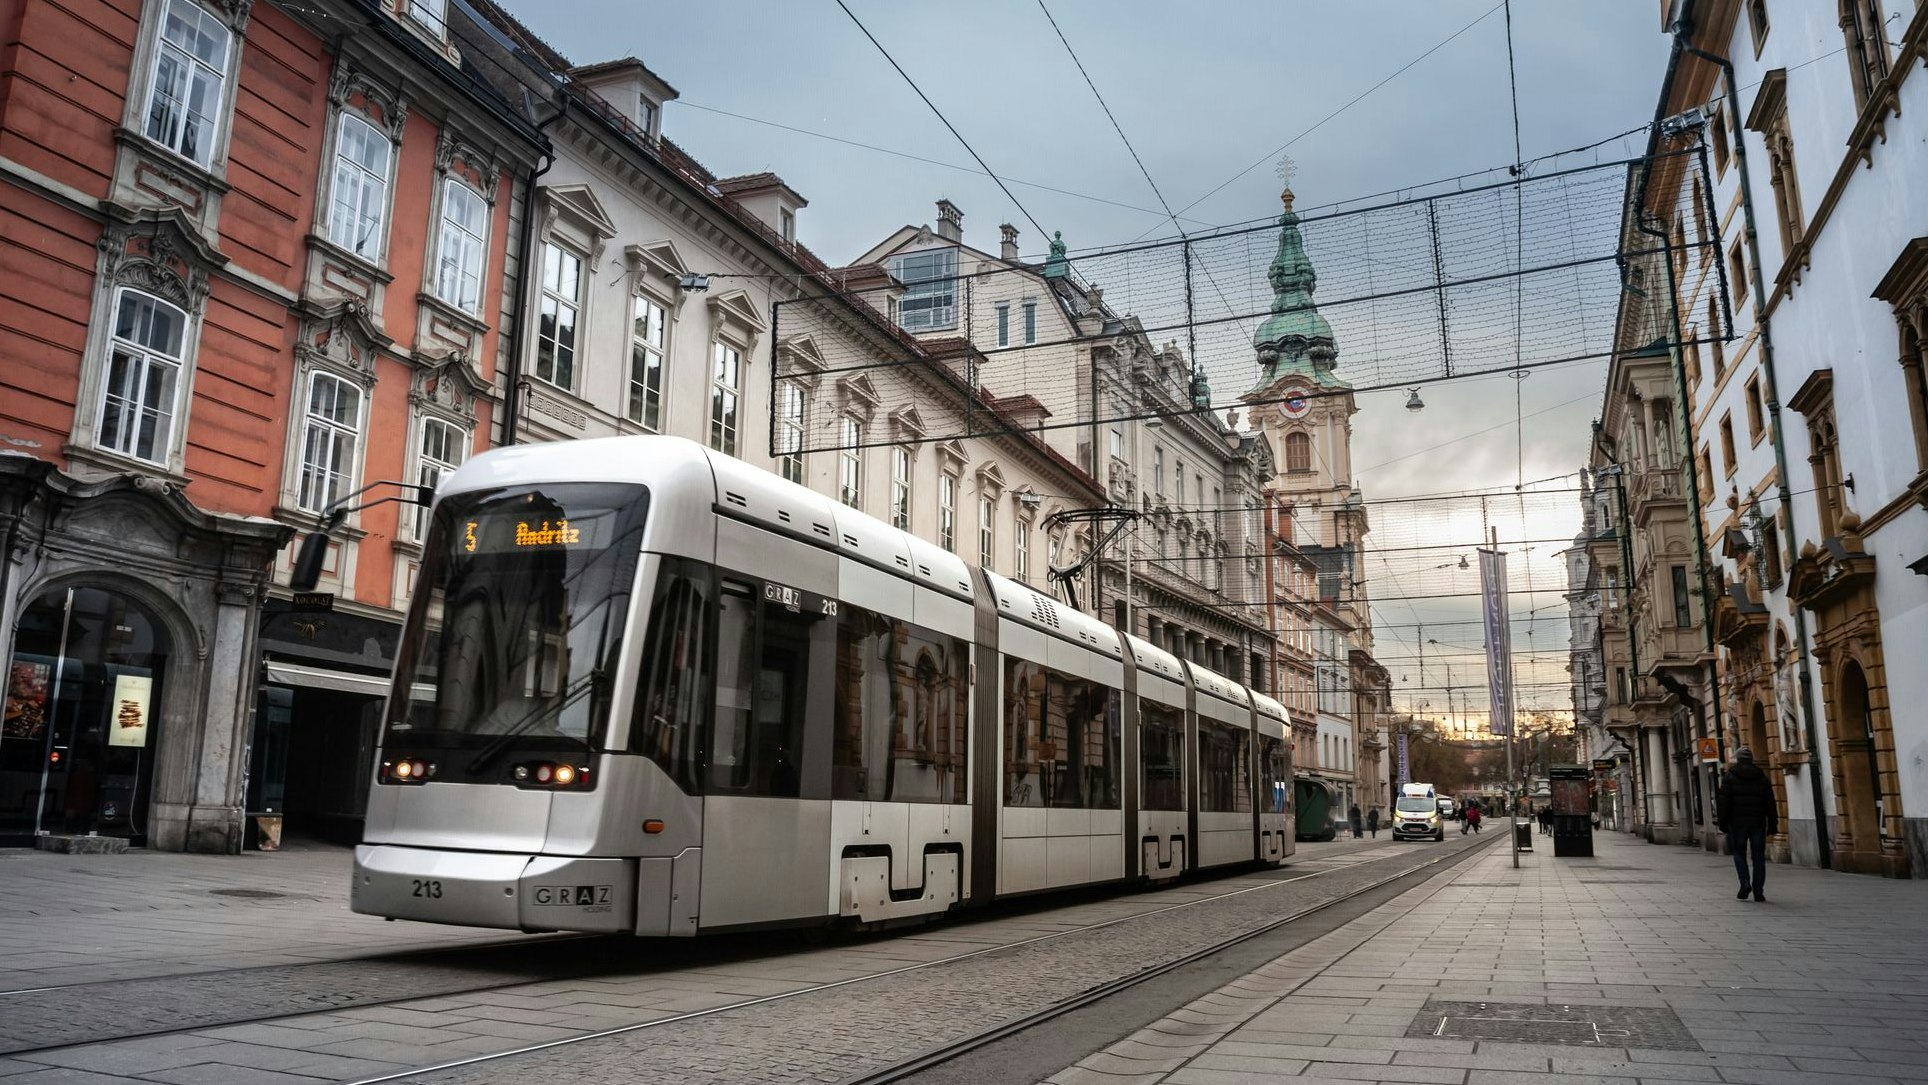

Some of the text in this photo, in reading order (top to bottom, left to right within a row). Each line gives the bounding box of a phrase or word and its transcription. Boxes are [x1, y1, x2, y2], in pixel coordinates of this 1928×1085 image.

[465, 522, 477, 552] 5
[766, 583, 800, 606] GRAZ
[822, 599, 838, 616] 213
[412, 879, 443, 899] 213
[535, 887, 612, 904] GRAZ
